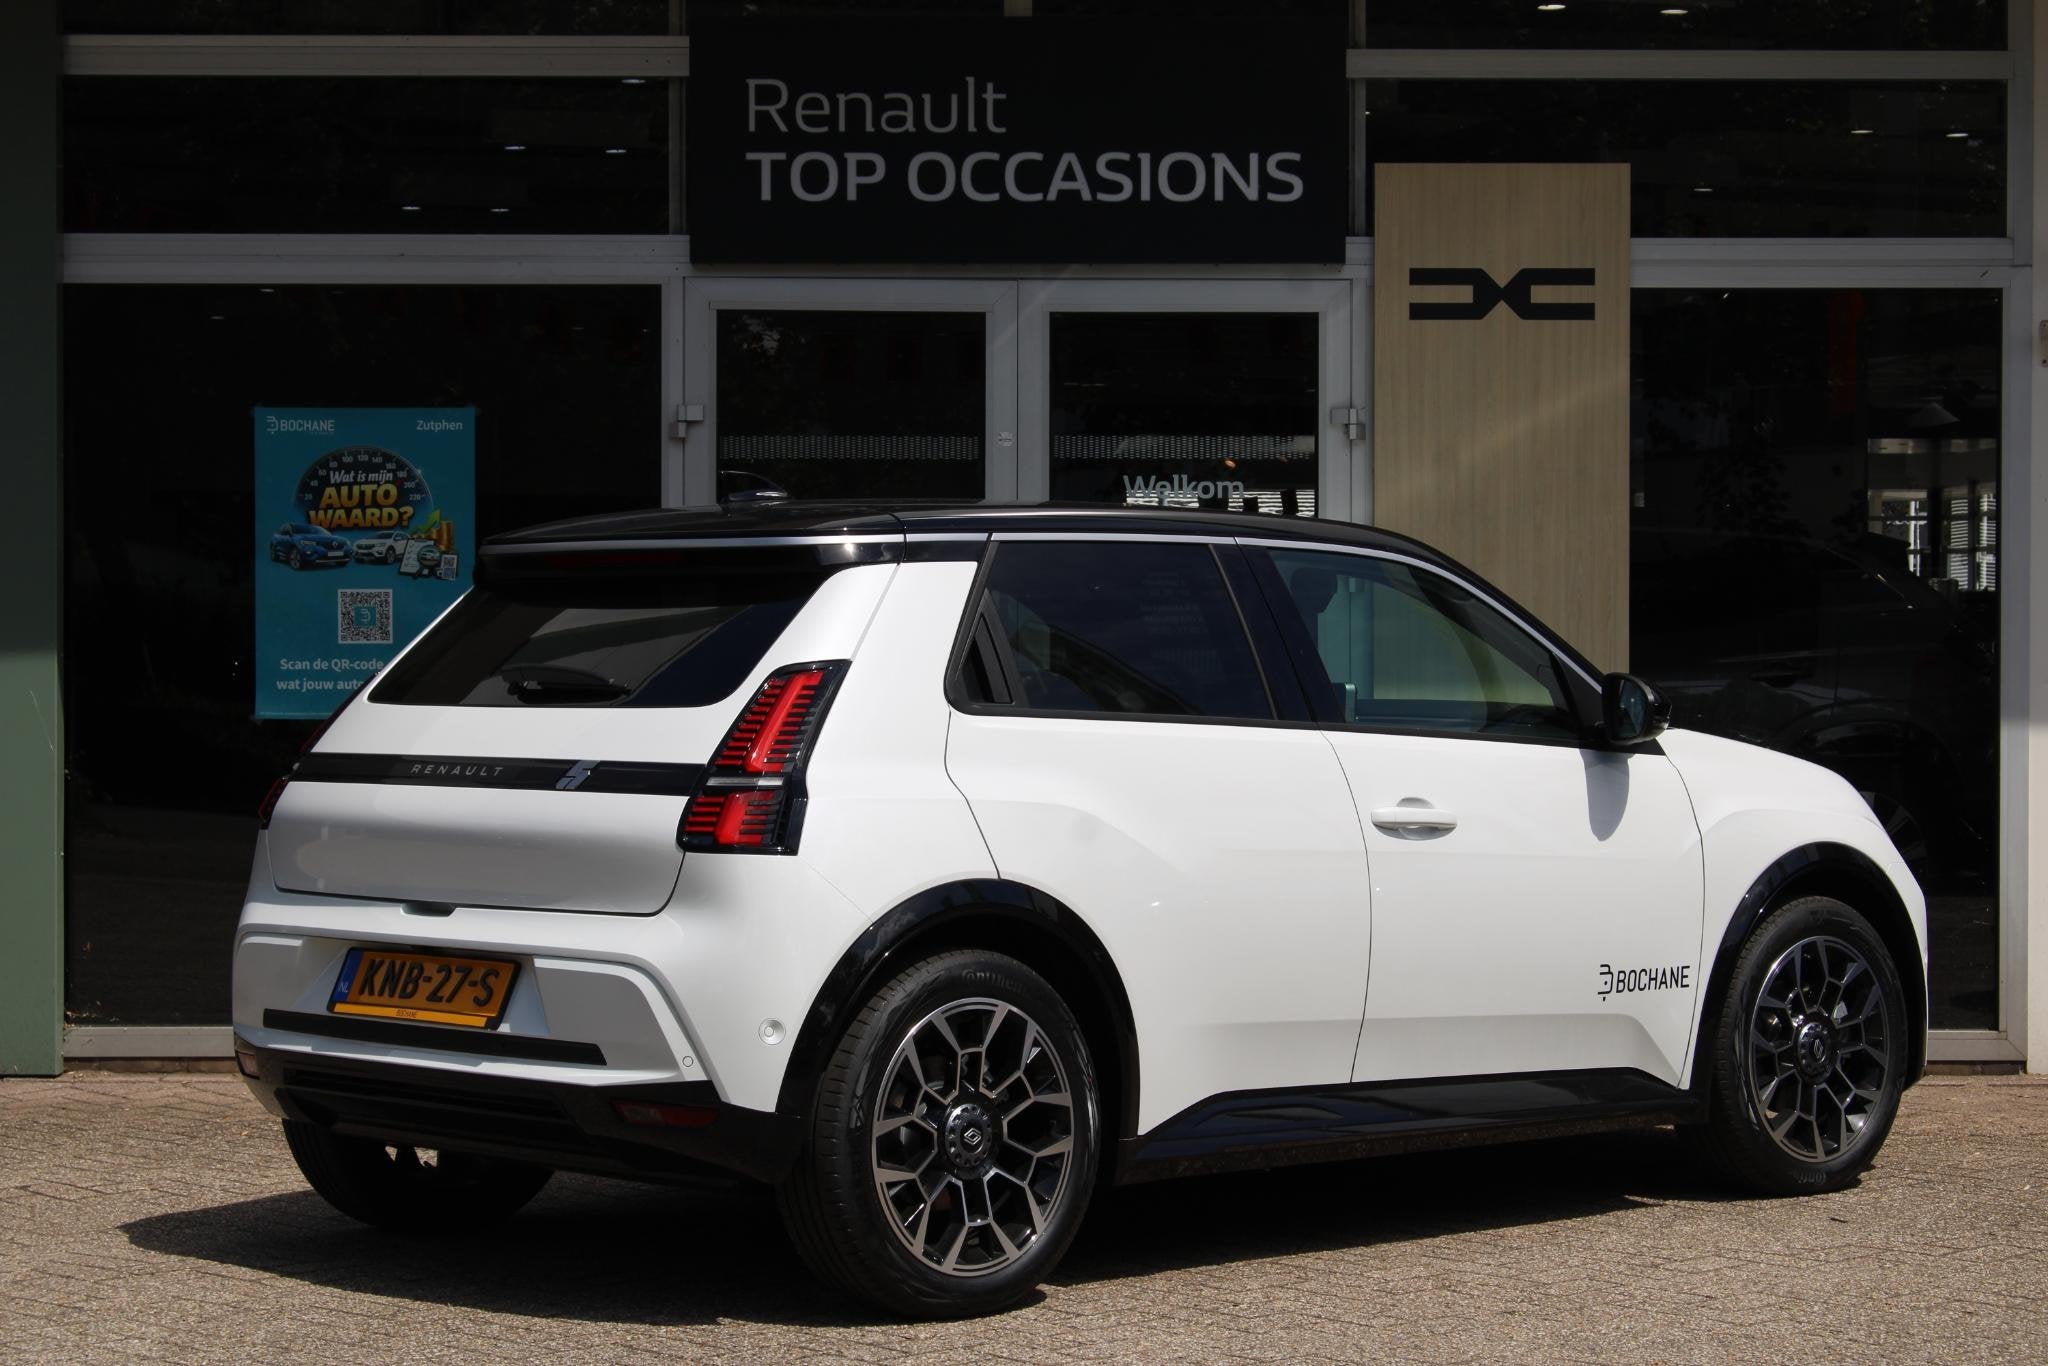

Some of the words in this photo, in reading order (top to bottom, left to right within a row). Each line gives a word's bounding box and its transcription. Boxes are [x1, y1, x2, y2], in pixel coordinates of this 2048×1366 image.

[745, 75, 1007, 134] Renault
[745, 151, 886, 202] TOP
[907, 151, 1304, 202] OCCASIONS
[280, 419, 335, 432] BOCHANE
[416, 419, 463, 433] Zutphen
[329, 470, 354, 484] Wat
[356, 470, 367, 483] is
[368, 470, 393, 484] mijn
[319, 483, 399, 509] AUTO
[1122, 474, 1245, 500] Welkom
[308, 505, 414, 529] WAARD?
[280, 658, 310, 670] Scan
[313, 658, 329, 670] de
[331, 658, 385, 672] QR-code
[276, 680, 301, 690] wat
[302, 678, 334, 693] jouw
[410, 763, 504, 777] RENAULT
[337, 981, 349, 993] NL
[358, 958, 500, 1008] KNB-27-S
[1616, 965, 1691, 994] BOCHANE
